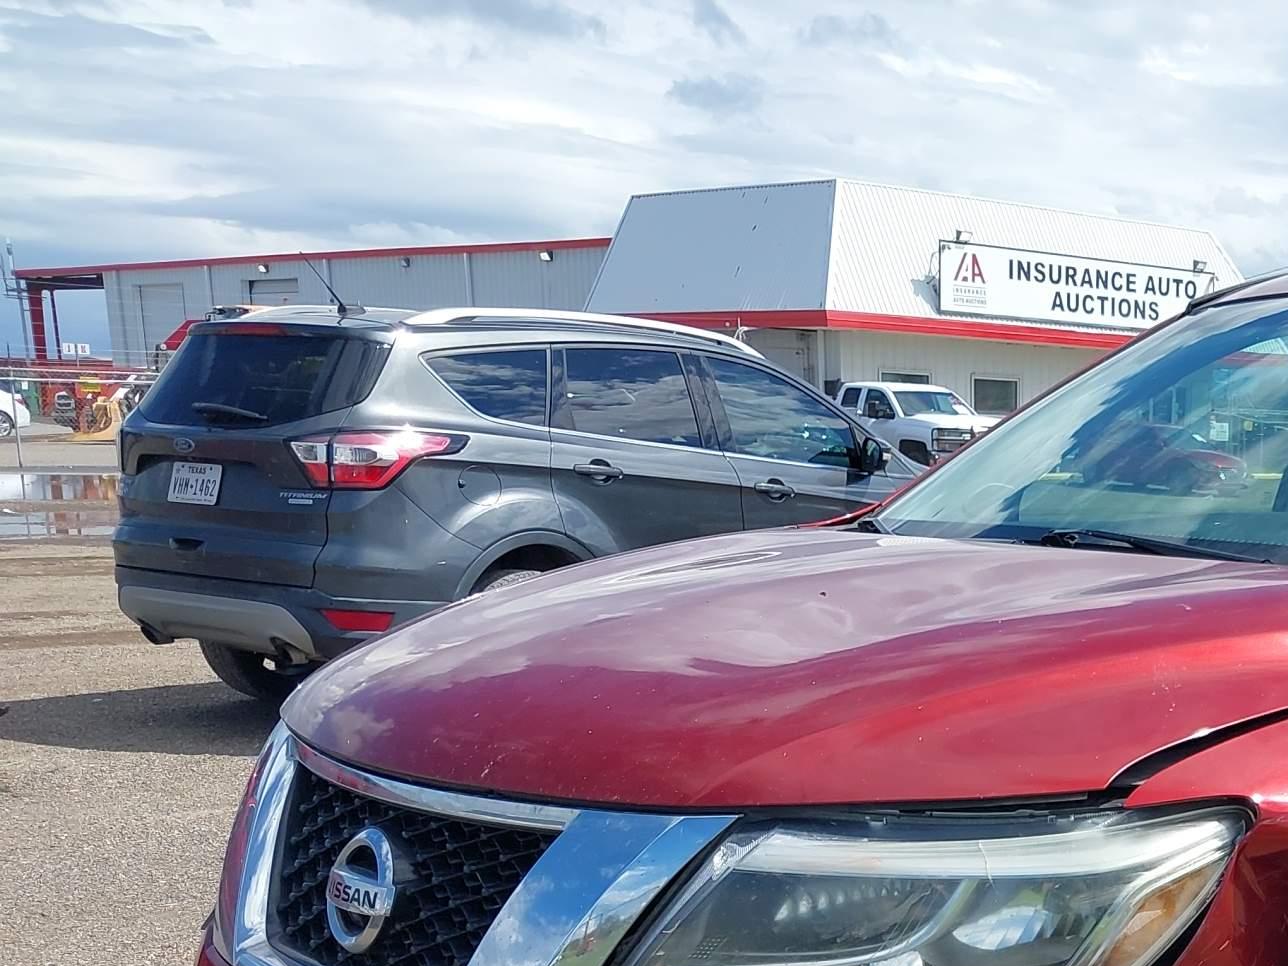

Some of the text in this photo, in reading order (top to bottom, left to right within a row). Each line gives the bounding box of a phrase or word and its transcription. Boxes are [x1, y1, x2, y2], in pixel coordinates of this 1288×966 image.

[1008, 259, 1198, 300] INSURANCE AUTO
[1051, 291, 1160, 321] AUCTIONS
[188, 466, 207, 475] TEXAS
